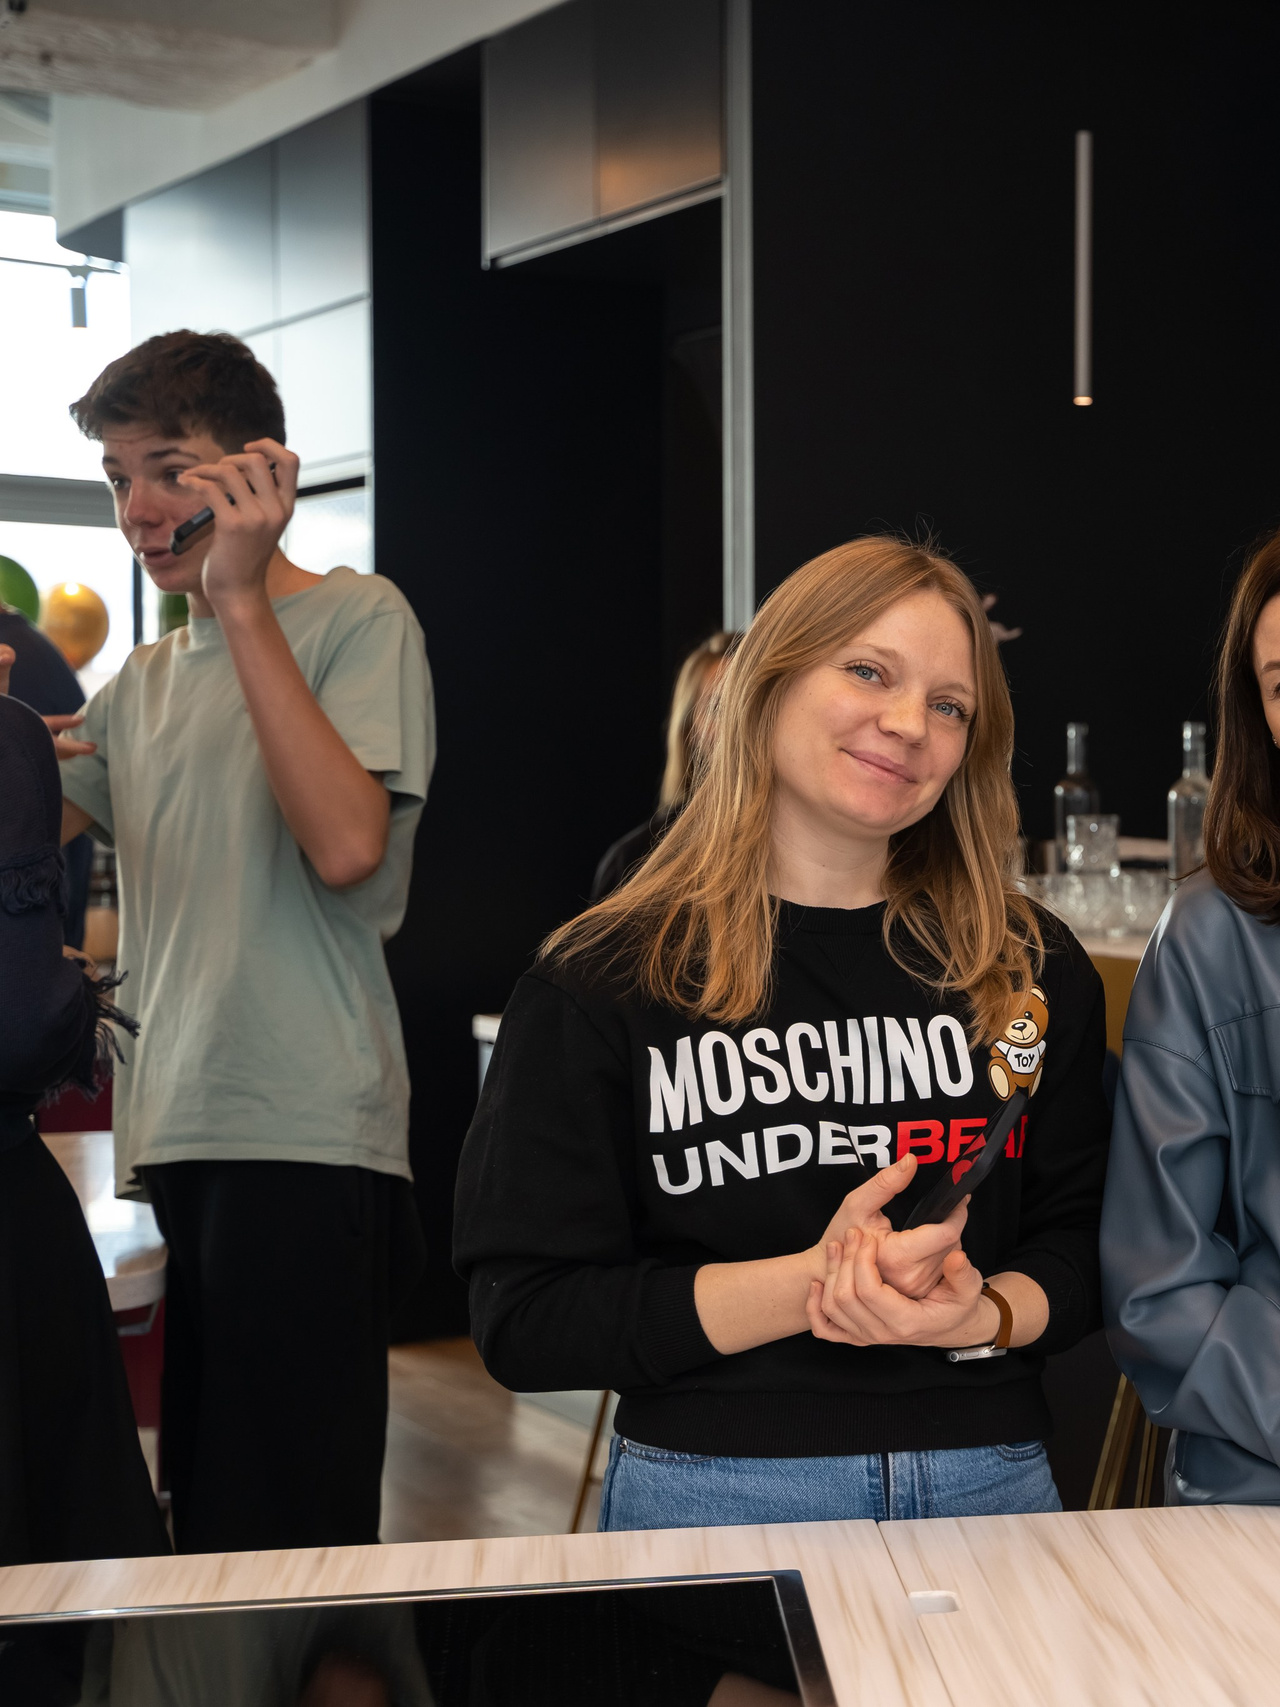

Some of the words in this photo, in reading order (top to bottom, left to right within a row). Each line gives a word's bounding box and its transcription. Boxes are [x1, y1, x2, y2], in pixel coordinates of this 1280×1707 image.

[647, 1014, 974, 1133] MOSCHINO
[1014, 1053, 1035, 1068] TOY
[652, 1115, 1029, 1195] UNDERBE
